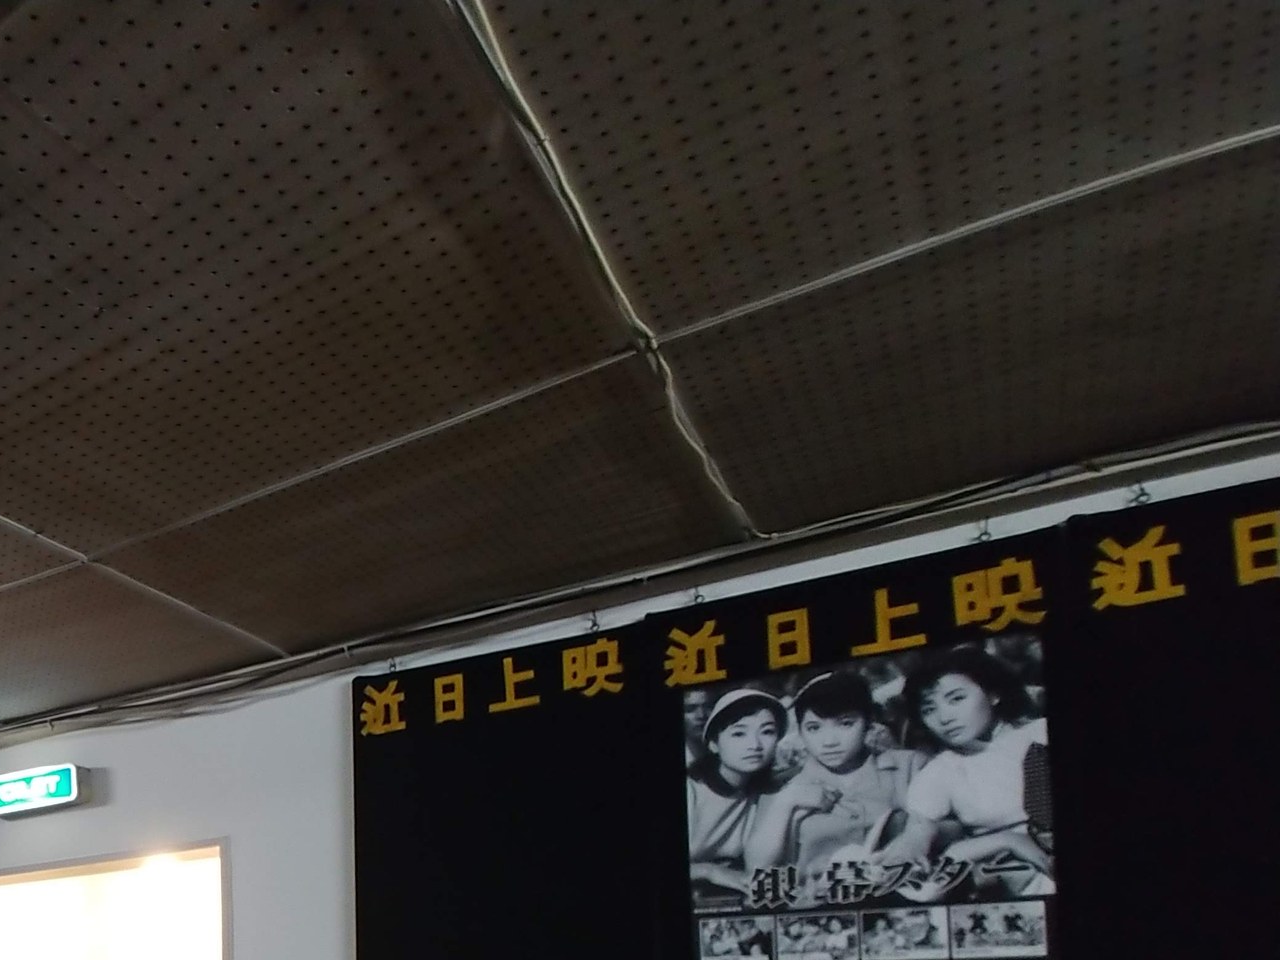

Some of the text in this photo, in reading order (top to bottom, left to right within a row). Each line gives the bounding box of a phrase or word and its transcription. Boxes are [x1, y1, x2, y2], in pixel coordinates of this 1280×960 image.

[1091, 510, 1280, 610] 近日
[665, 558, 1045, 688] 近日上映
[360, 637, 624, 737] 近日上映
[749, 857, 1032, 907] 銀幕スター
